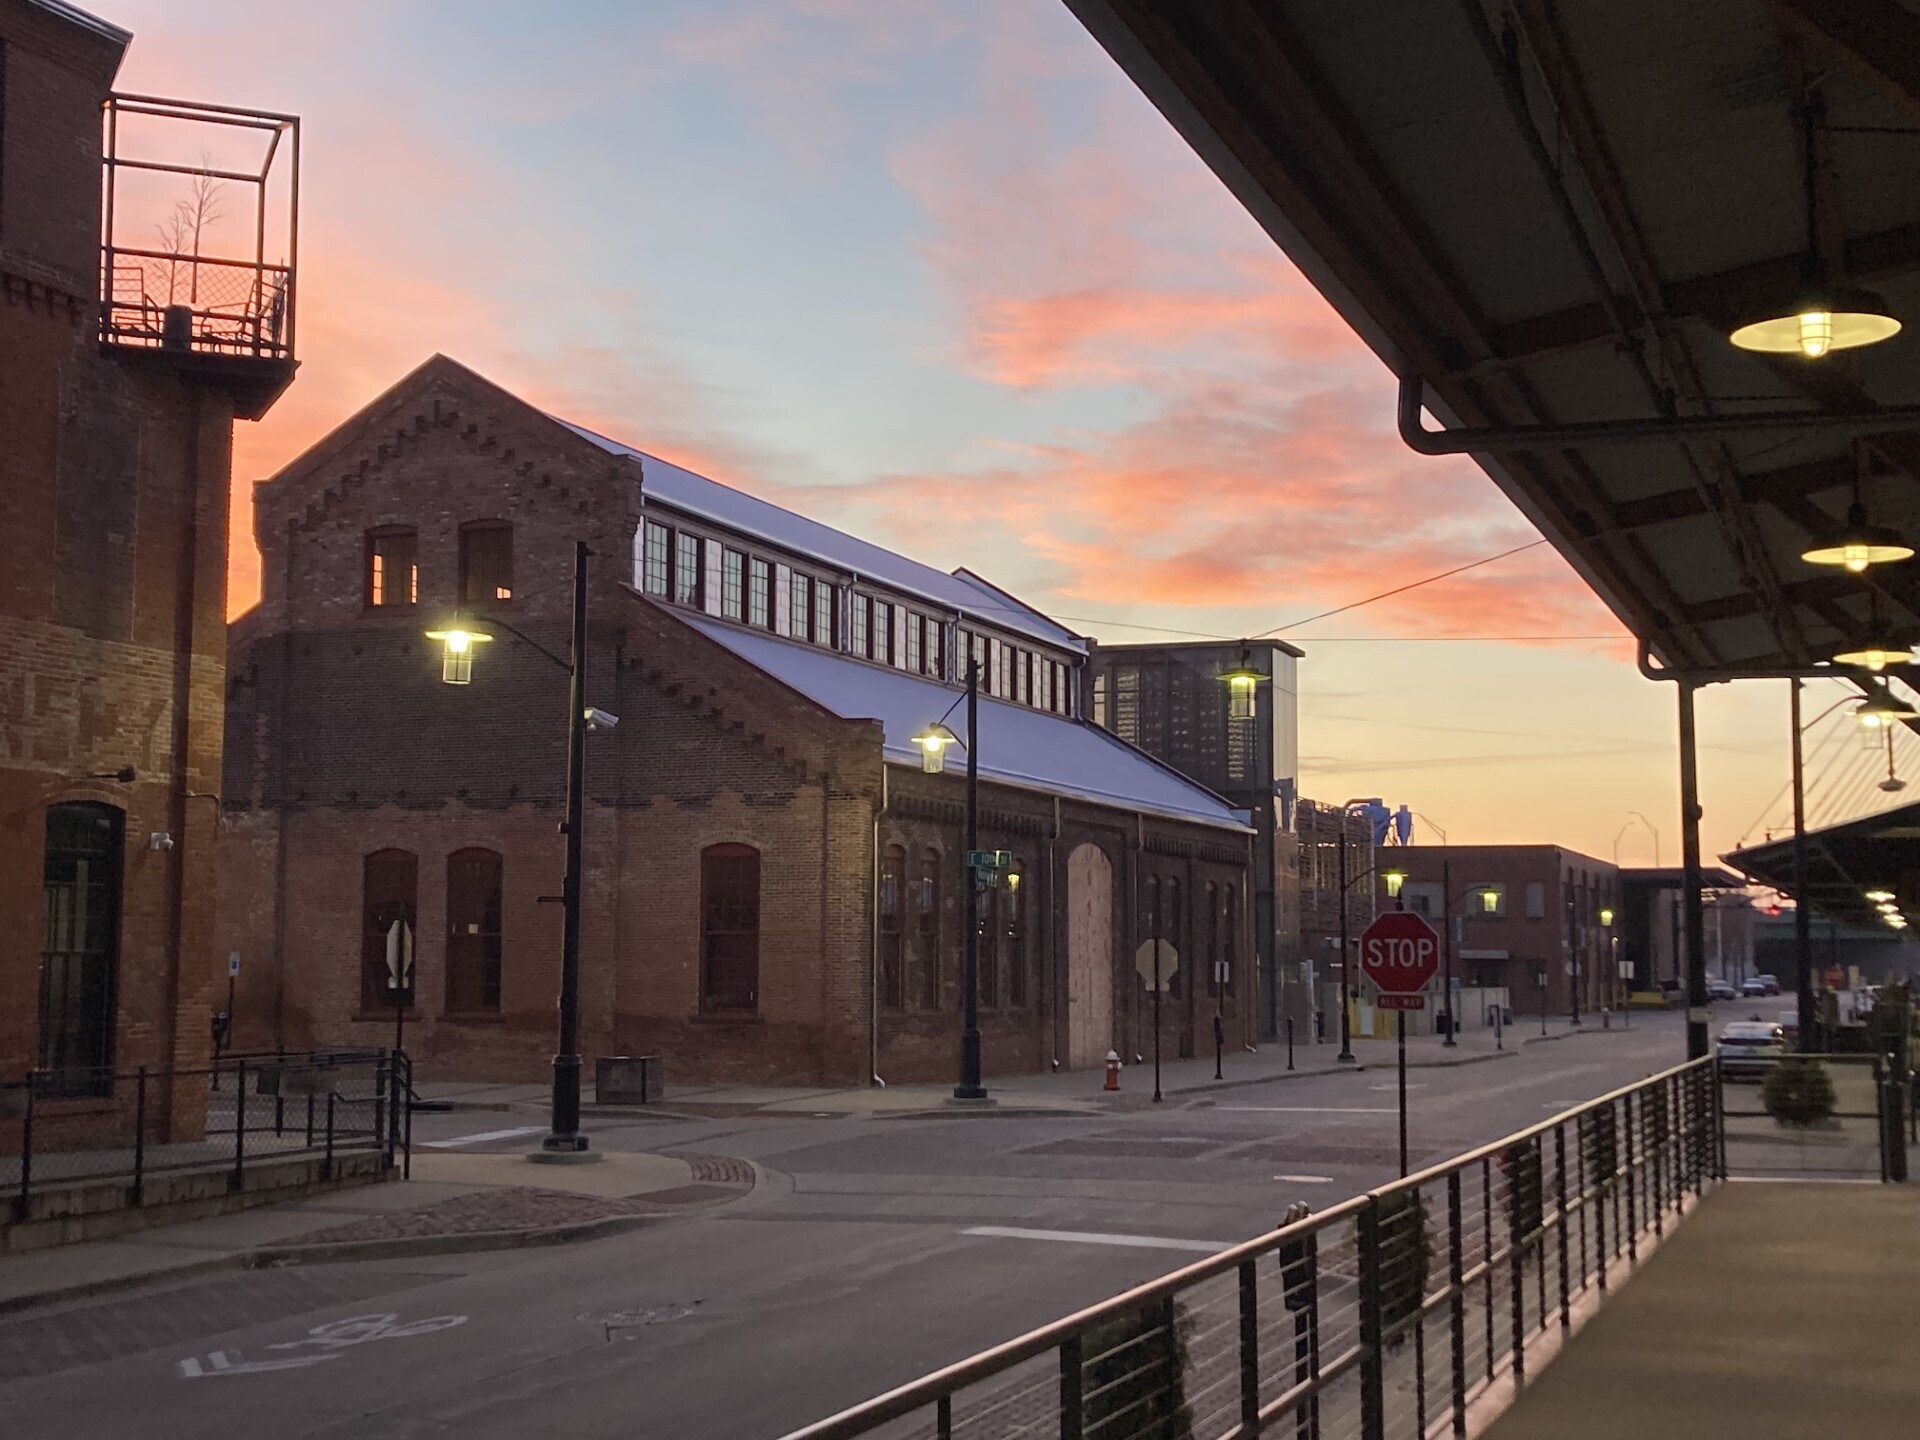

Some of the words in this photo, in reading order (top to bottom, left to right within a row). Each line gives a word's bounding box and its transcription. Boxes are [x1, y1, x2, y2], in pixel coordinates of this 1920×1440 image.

[970, 853, 976, 864] E
[1367, 938, 1433, 968] STOP
[1380, 997, 1397, 1007] ALL
[1403, 997, 1422, 1007] WAY
